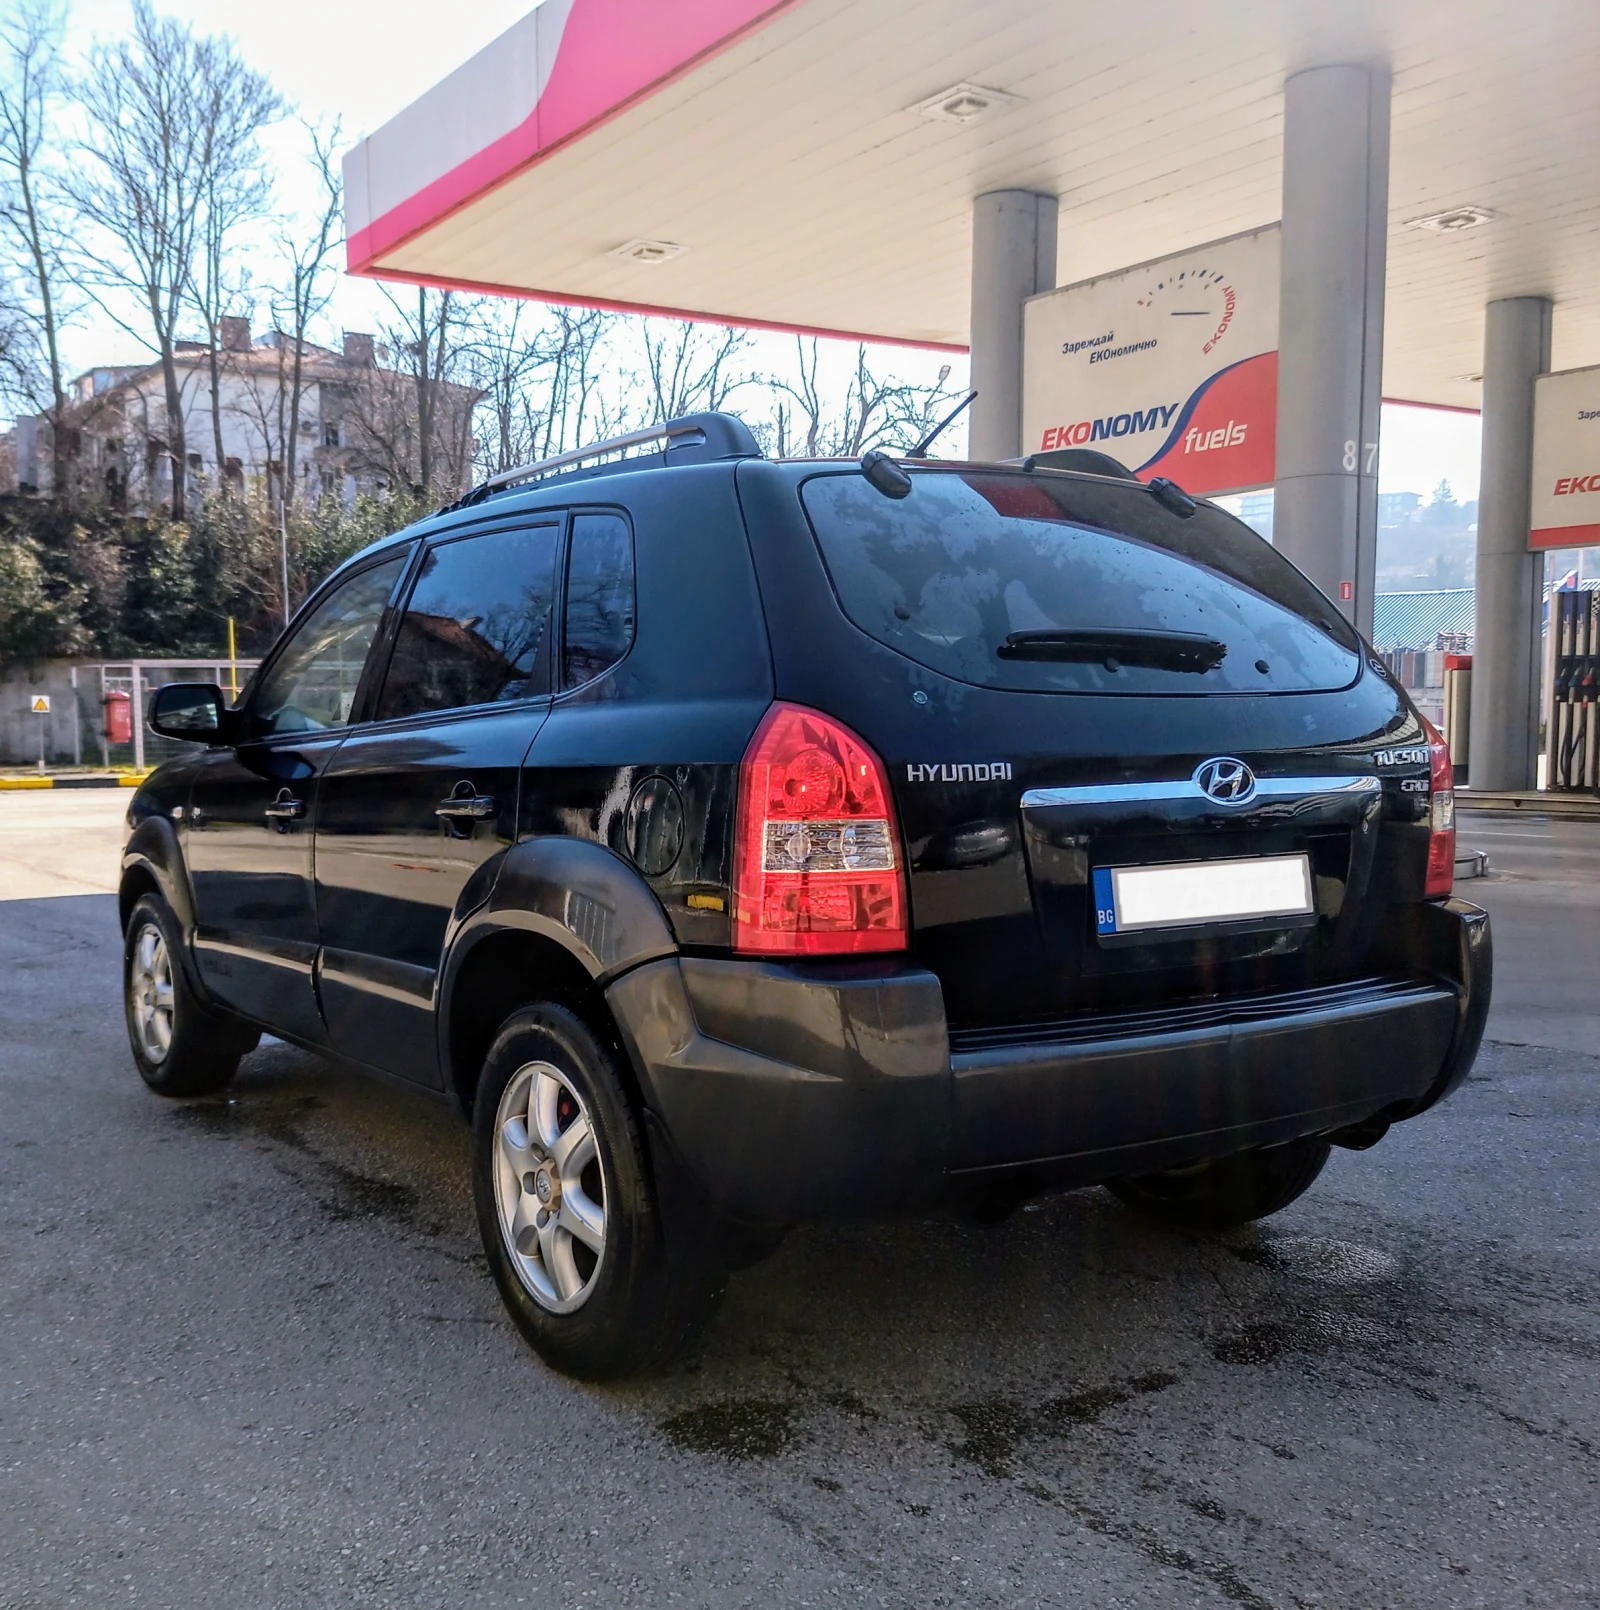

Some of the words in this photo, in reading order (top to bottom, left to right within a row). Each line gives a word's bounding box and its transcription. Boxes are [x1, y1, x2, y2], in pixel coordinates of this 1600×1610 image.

[1202, 285, 1236, 355] EKONOMY
[1062, 330, 1114, 354] Зареждай
[1089, 338, 1158, 364] ЕКОномично
[1041, 403, 1179, 451] EKONOMY
[1184, 420, 1247, 454] fuels
[907, 762, 1012, 782] HYUNDAI
[1097, 909, 1114, 924] BG
